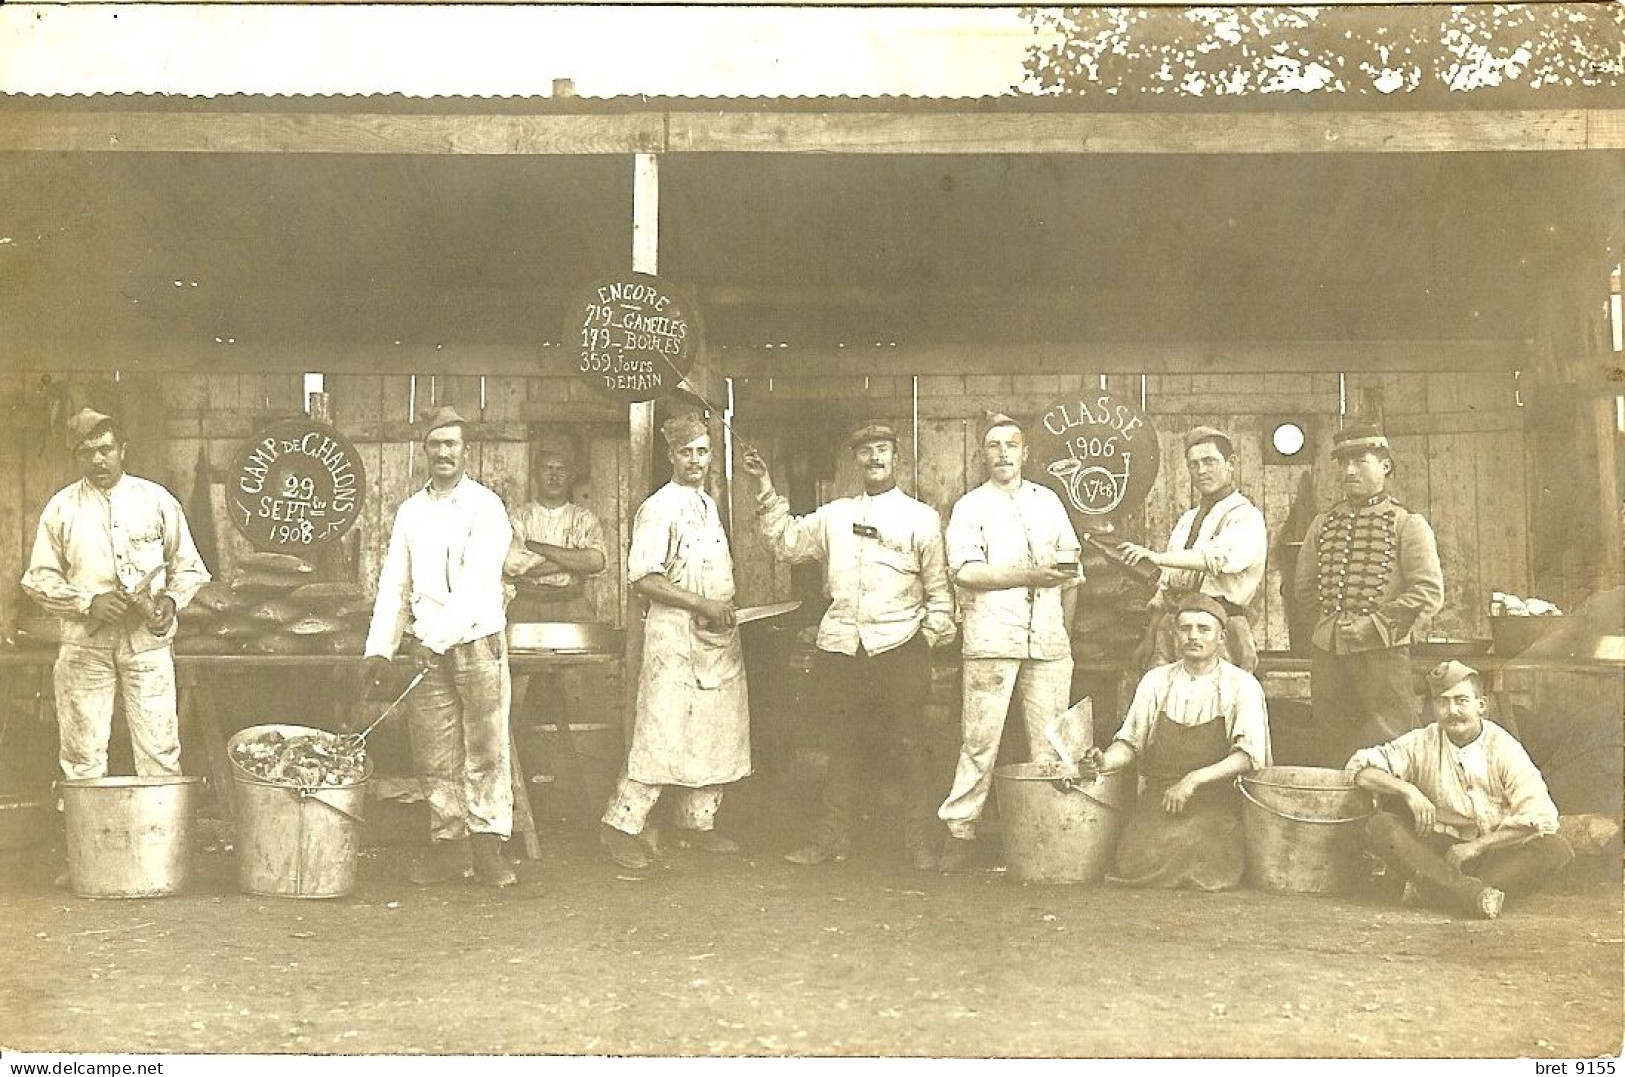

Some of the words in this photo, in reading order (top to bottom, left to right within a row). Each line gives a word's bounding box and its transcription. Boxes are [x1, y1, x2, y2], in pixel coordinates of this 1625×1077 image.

[598, 283, 670, 311] ENCORE
[585, 304, 612, 327] 719
[580, 351, 611, 372] 359
[604, 373, 661, 390] DEMAIN
[1043, 396, 1143, 441] CLASSE
[1065, 436, 1118, 460] 1906
[240, 438, 279, 493] CAMP
[281, 439, 301, 453] DE
[301, 432, 357, 512] CHALONS
[282, 476, 314, 500] 29
